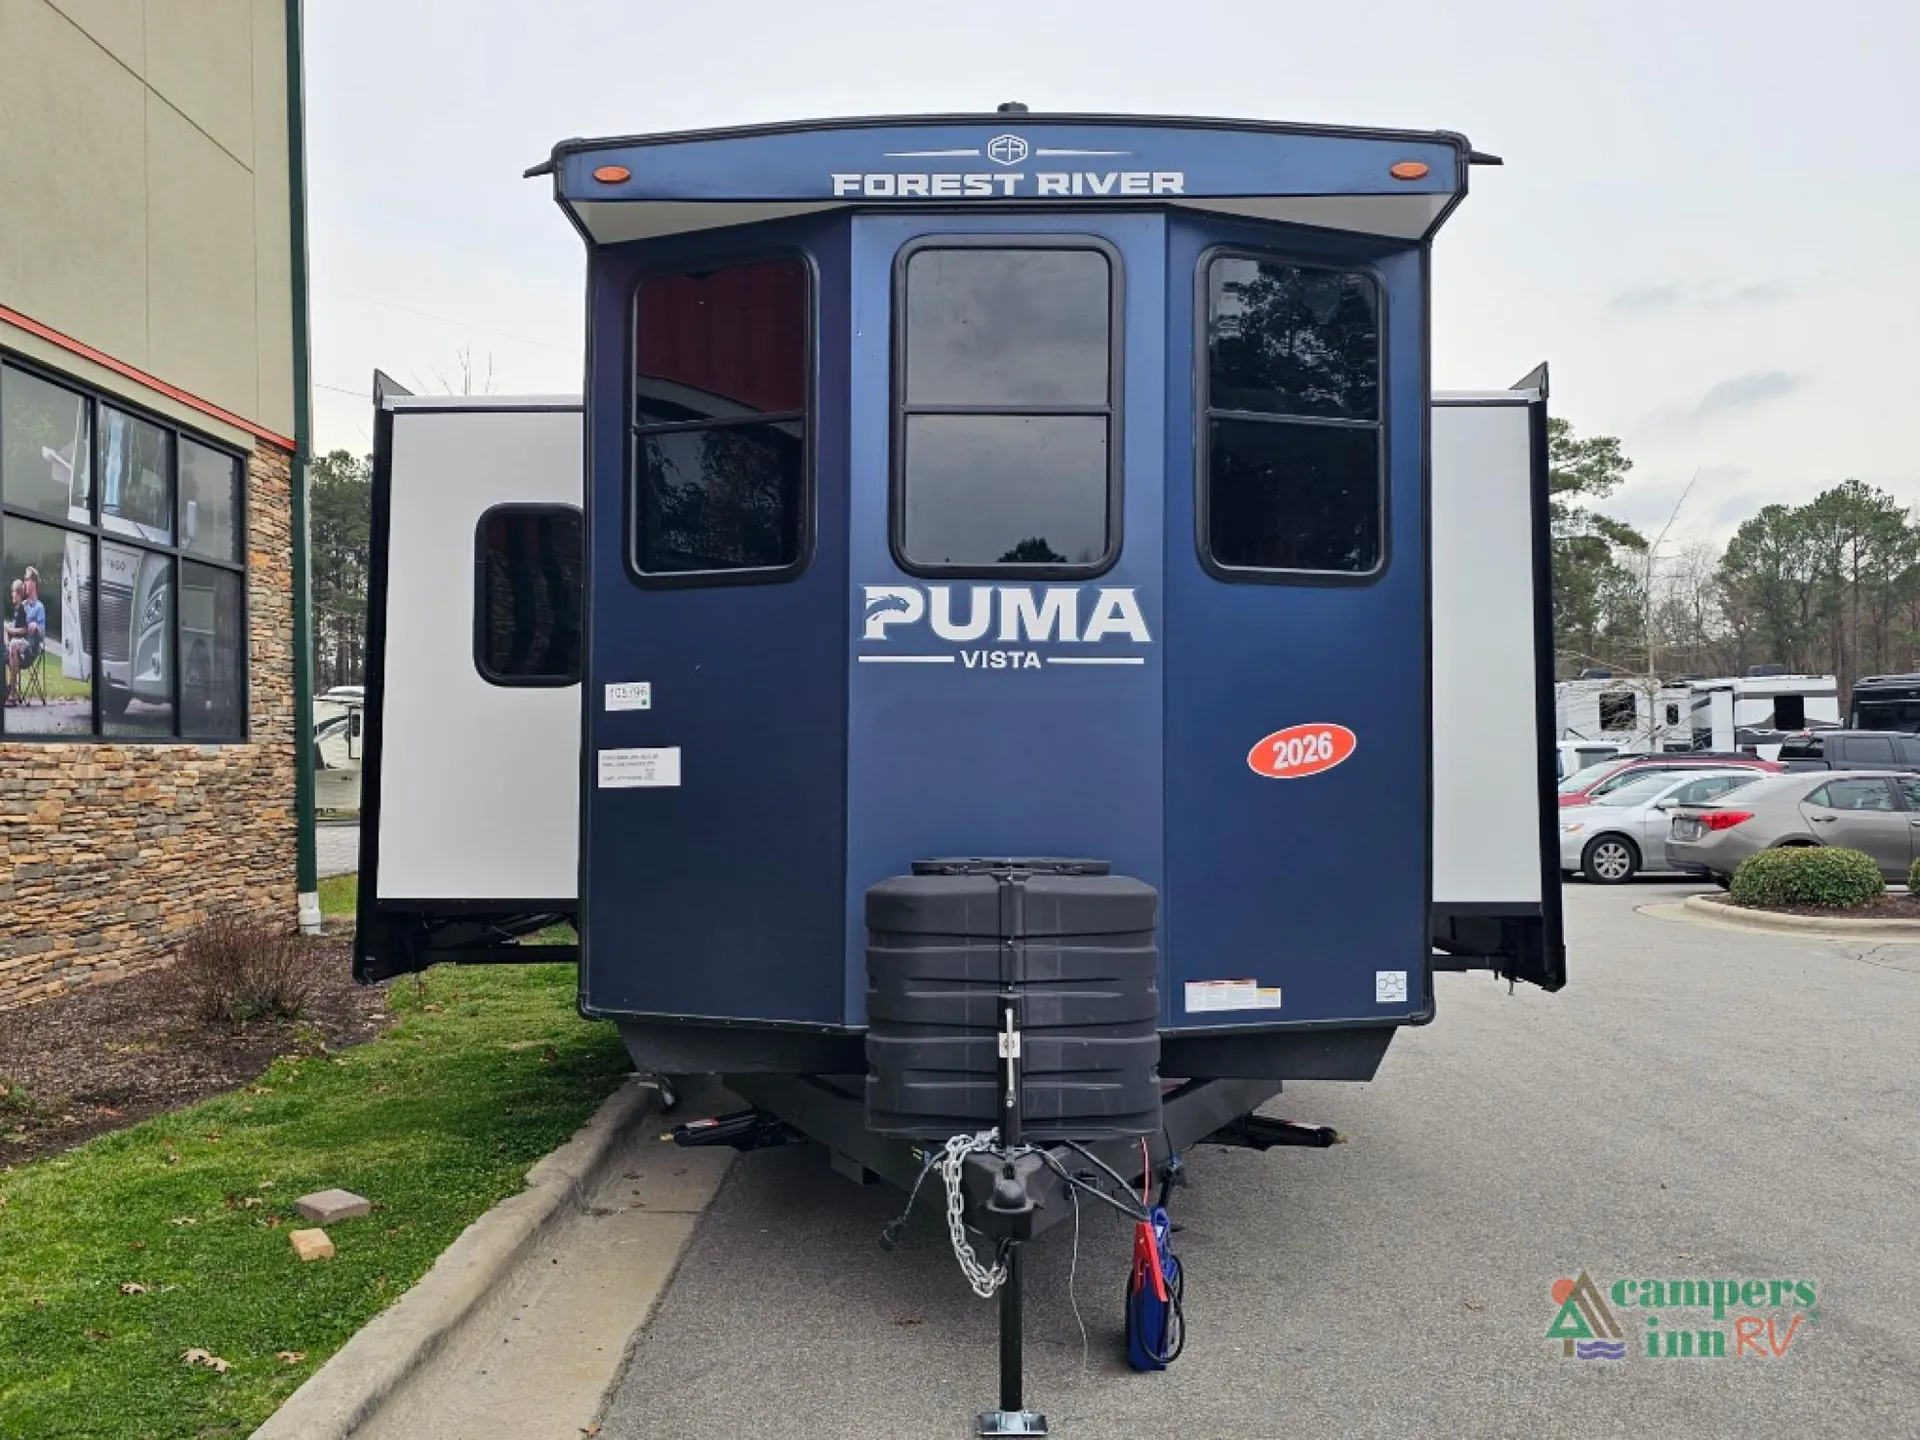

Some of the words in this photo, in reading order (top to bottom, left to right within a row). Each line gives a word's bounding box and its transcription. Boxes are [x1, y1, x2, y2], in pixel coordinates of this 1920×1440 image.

[831, 173, 1025, 197] FOREST
[1036, 172, 1185, 196] RIVER
[862, 585, 1152, 643] PUMA
[960, 650, 1042, 669] VISTA
[1272, 731, 1334, 769] 2026
